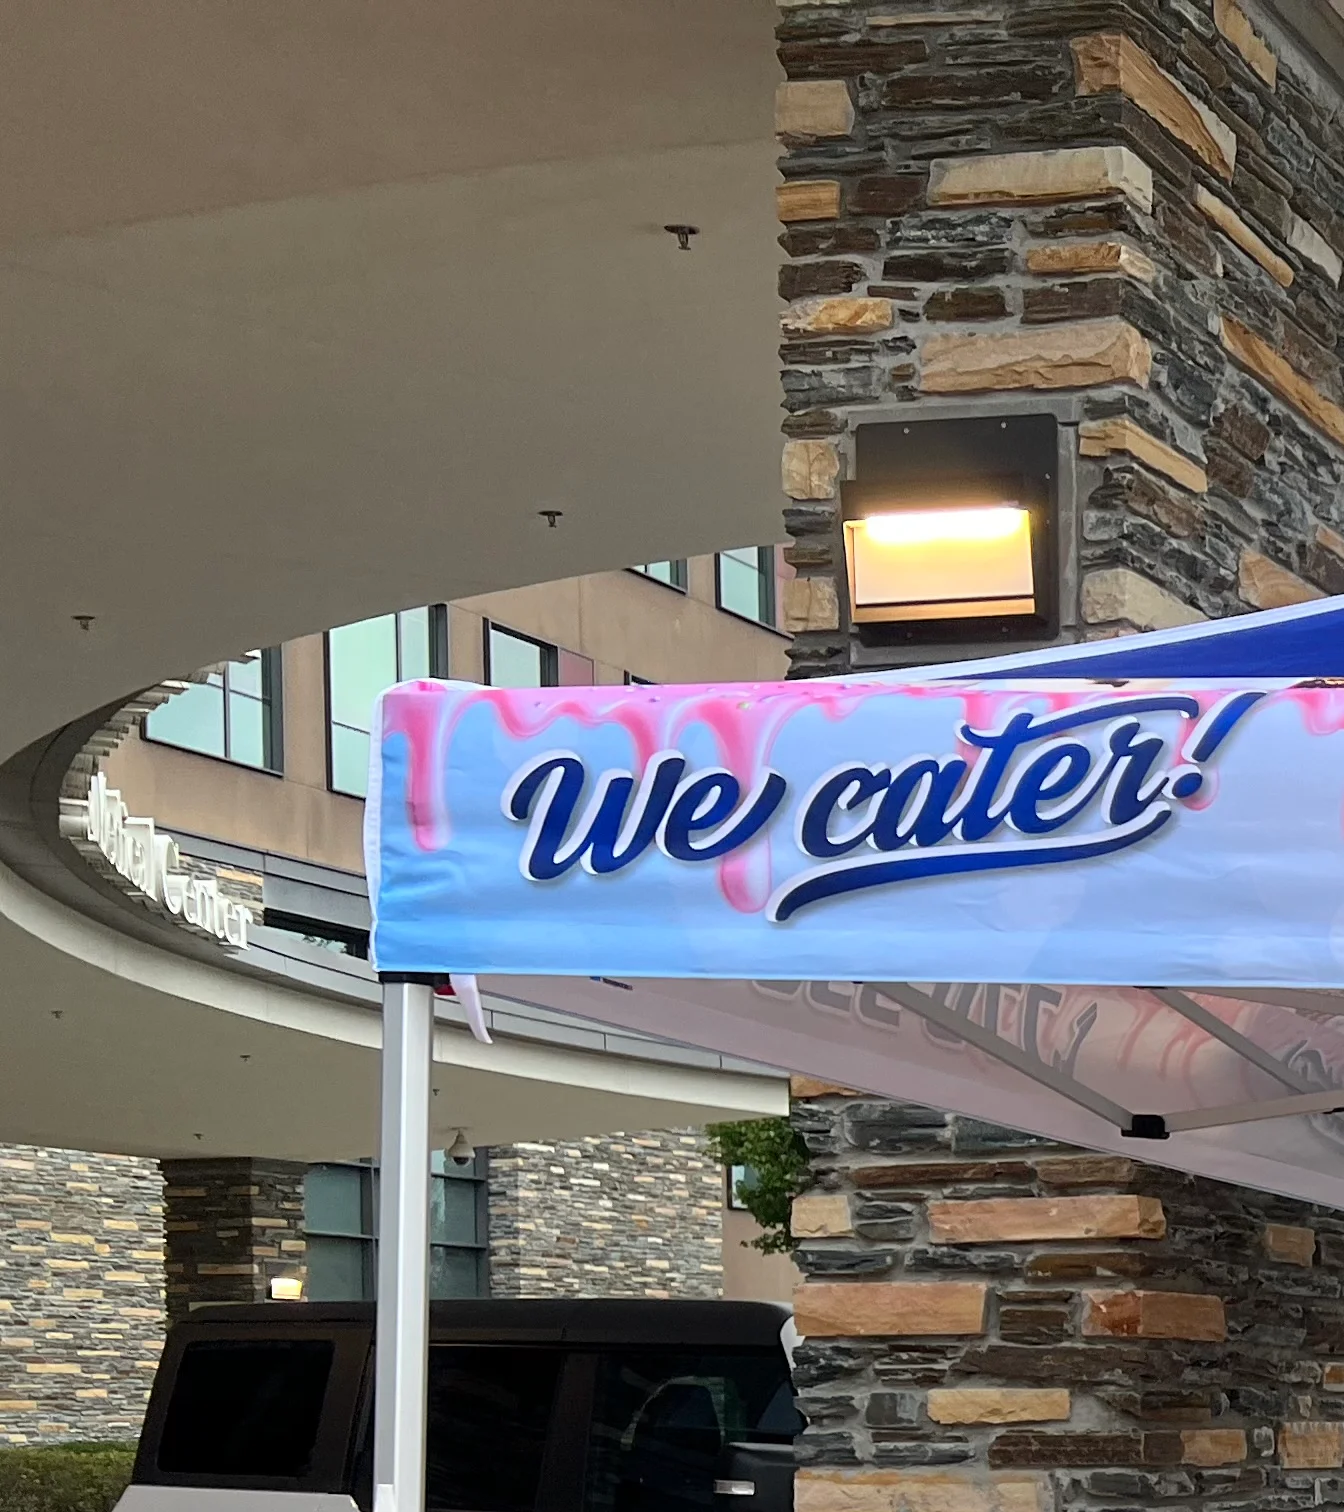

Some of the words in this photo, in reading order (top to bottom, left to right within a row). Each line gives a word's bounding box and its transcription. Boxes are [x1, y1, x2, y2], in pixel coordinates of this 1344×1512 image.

[501, 748, 789, 883] We
[772, 691, 1269, 905] cater!
[154, 834, 254, 951] Center
